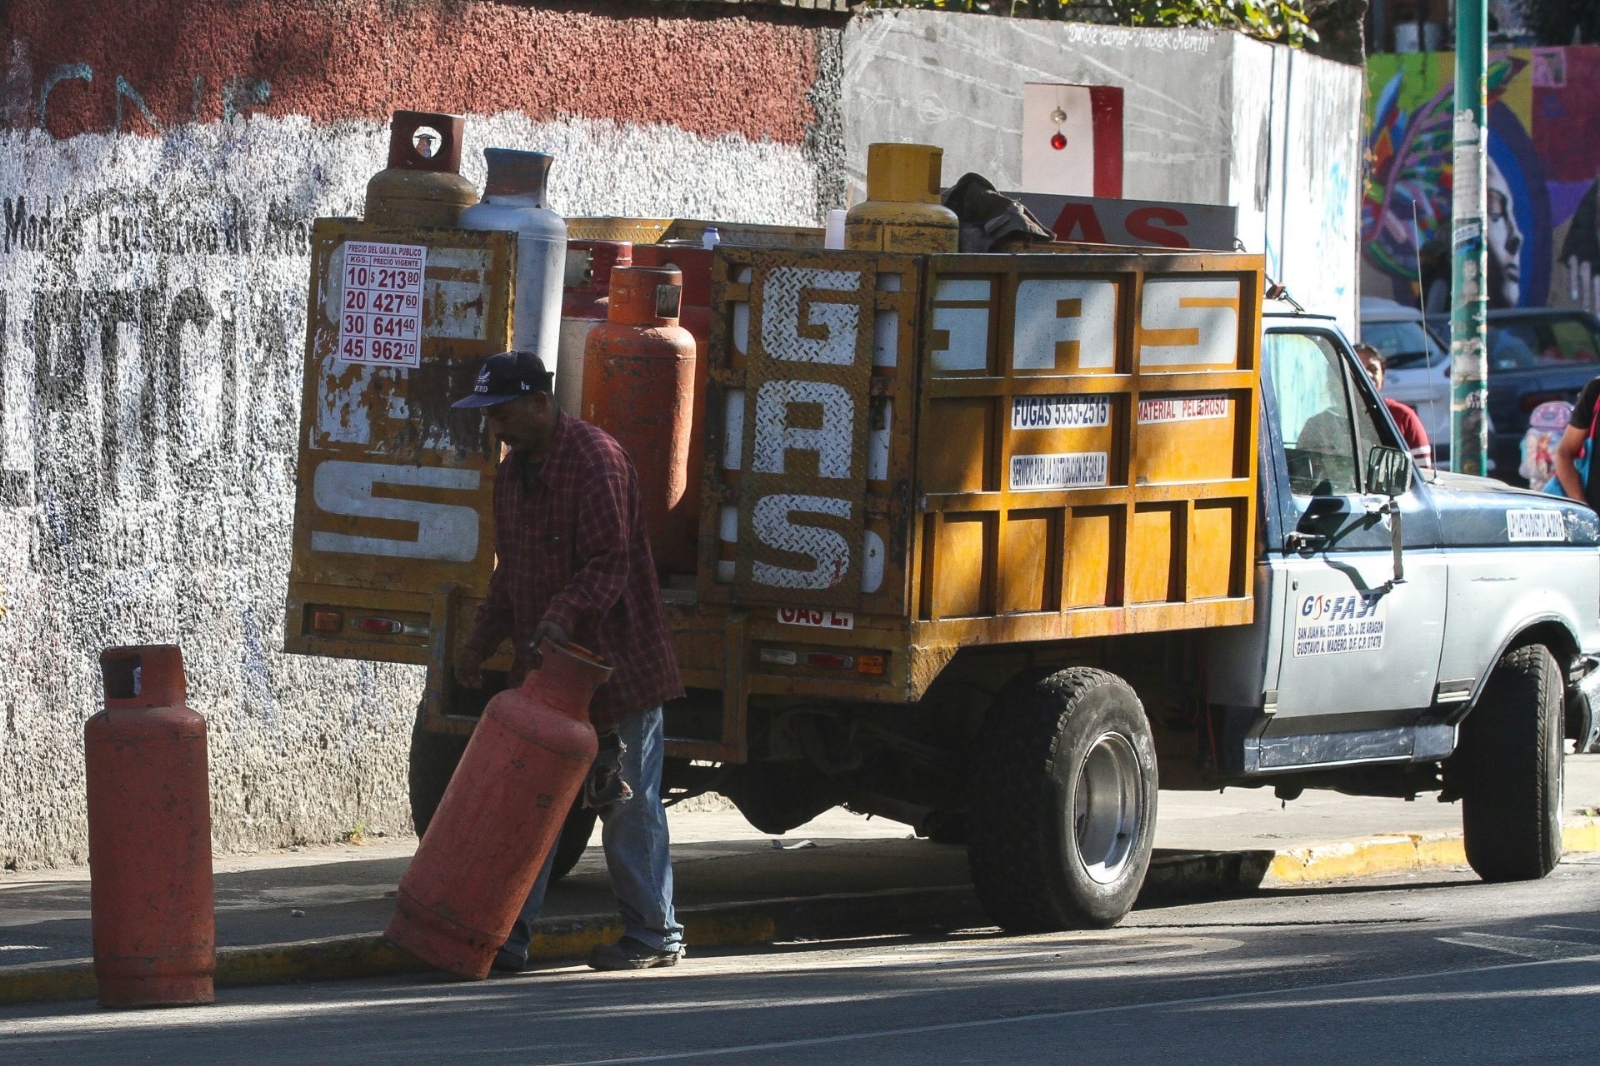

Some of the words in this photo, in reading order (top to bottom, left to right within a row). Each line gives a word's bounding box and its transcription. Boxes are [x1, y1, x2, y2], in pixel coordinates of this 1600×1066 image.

[1051, 202, 1191, 249] AS
[348, 244, 367, 253] PRECIO
[368, 246, 377, 254] DEL
[380, 247, 390, 255] GAS
[391, 247, 397, 255] AL
[399, 248, 422, 257] PUBLICO
[395, 259, 419, 267] VIGENTE
[348, 267, 367, 286] 10
[370, 272, 375, 283] $
[346, 290, 366, 310] 20
[344, 315, 364, 334] 30
[343, 338, 364, 357] 45
[1014, 397, 1052, 427] FUGAS
[1054, 395, 1107, 425] 5353-2515
[1138, 401, 1176, 421] MATERIAL
[752, 266, 861, 590] GAS
[1298, 627, 1307, 640] SAN
[1307, 626, 1319, 639] JUAN
[1359, 621, 1366, 634] DE
[1366, 620, 1384, 634] ARAGON
[1297, 641, 1320, 655] GUSTAVO
